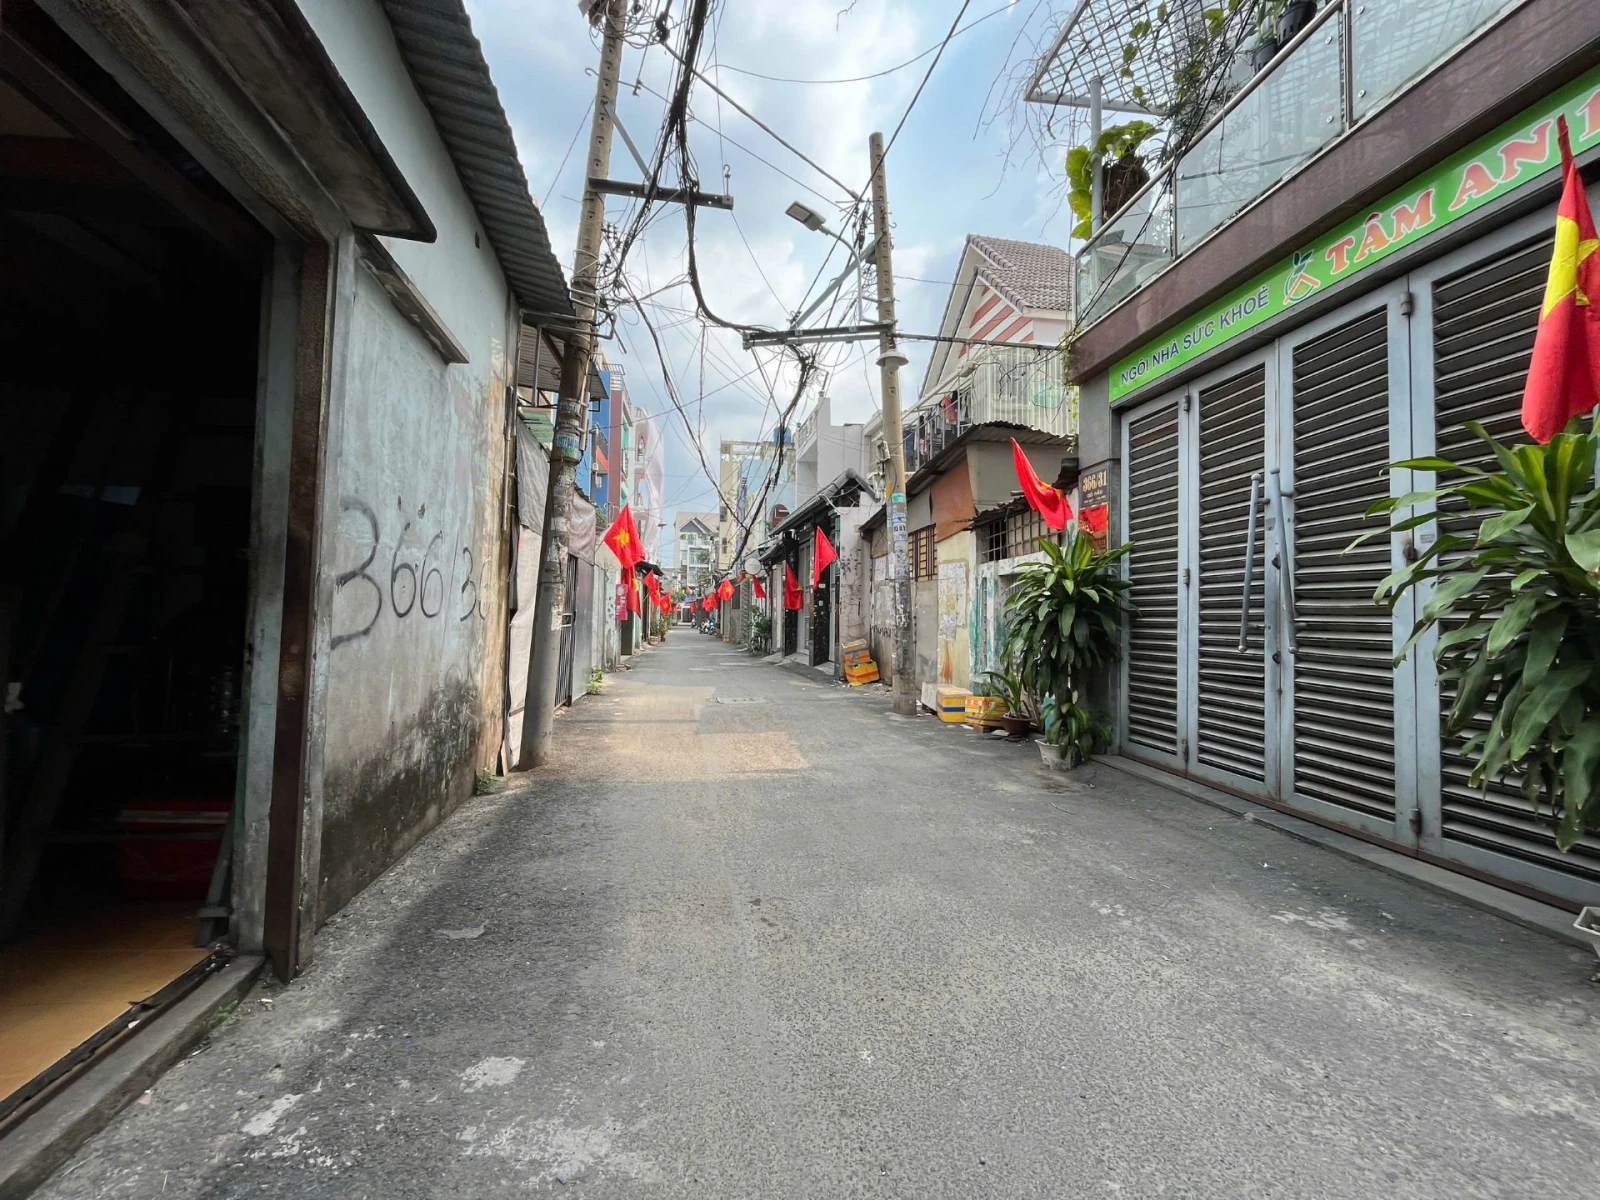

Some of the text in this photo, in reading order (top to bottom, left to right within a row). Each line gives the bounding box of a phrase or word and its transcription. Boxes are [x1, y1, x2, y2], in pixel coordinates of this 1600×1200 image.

[1324, 119, 1554, 275] TÂM AN
[1120, 357, 1149, 385] NGÔI
[1183, 321, 1215, 350] SỨC
[1082, 469, 1107, 492] 366/31
